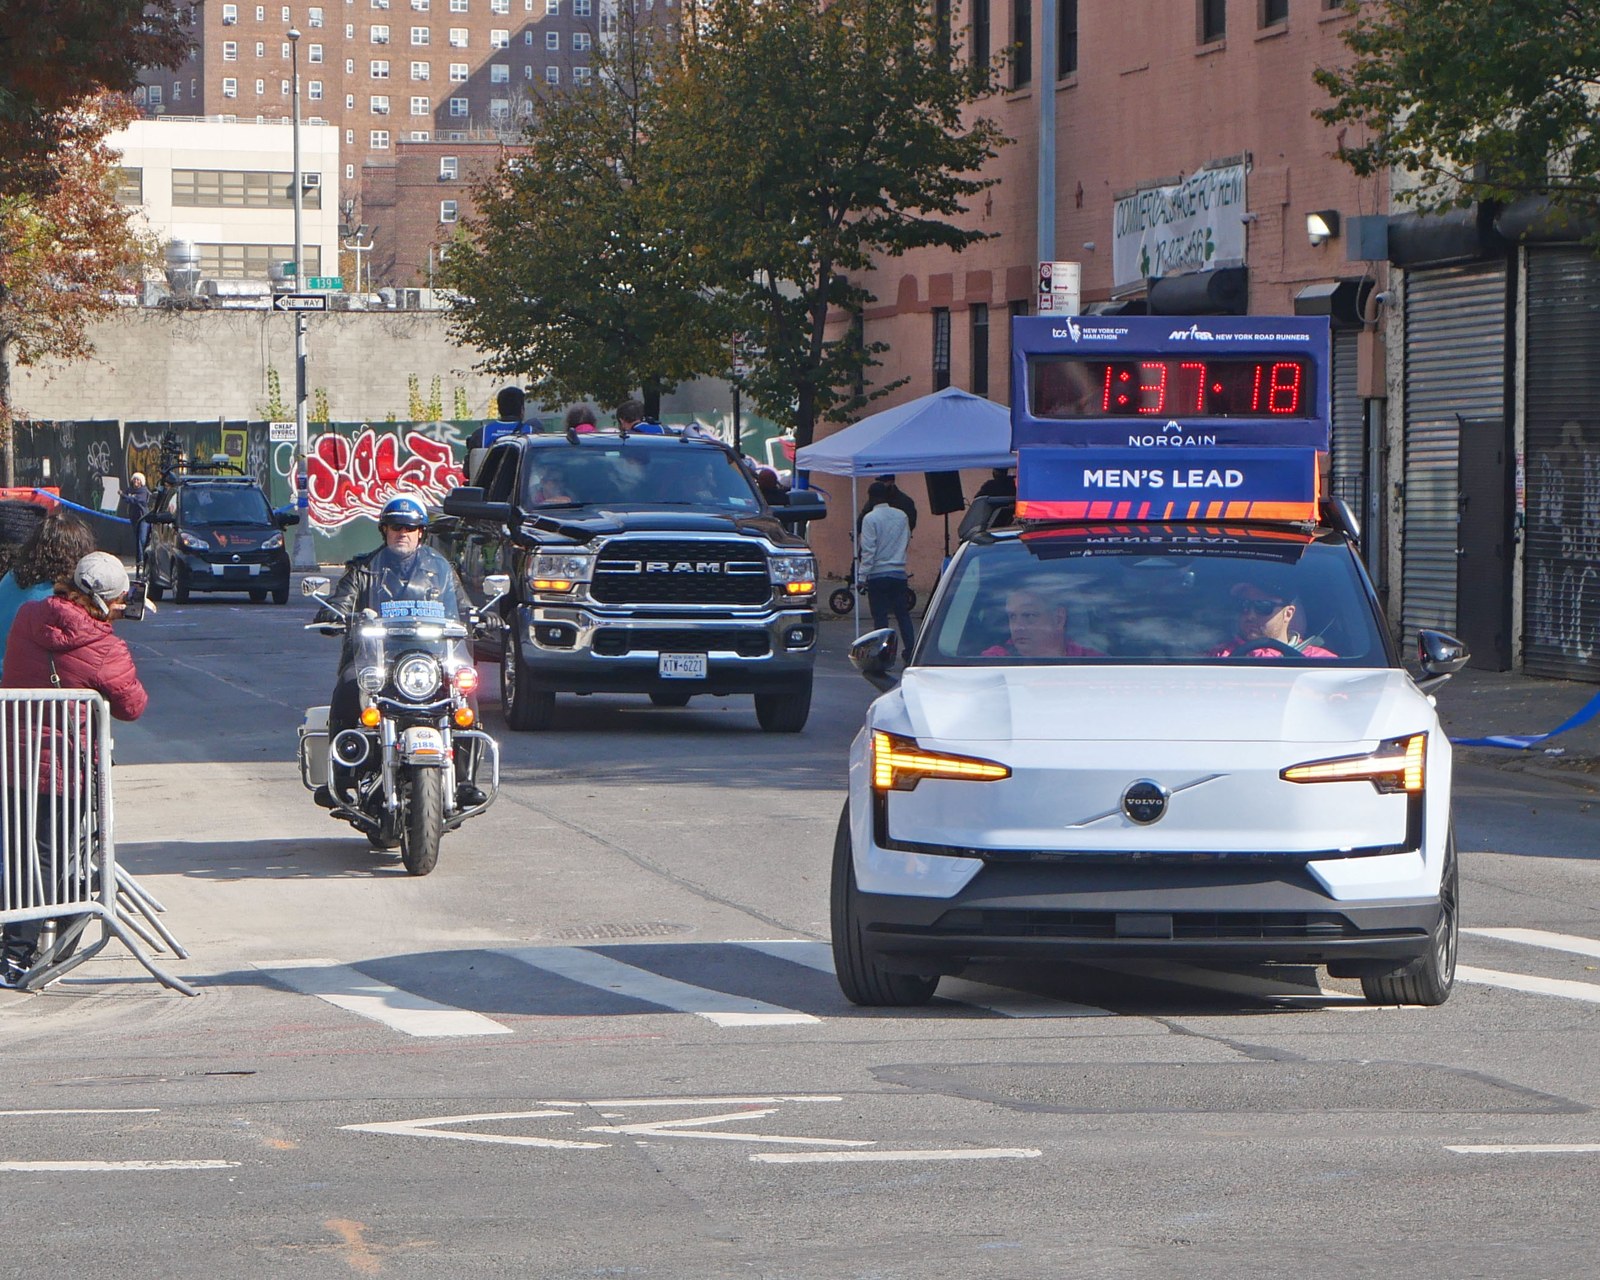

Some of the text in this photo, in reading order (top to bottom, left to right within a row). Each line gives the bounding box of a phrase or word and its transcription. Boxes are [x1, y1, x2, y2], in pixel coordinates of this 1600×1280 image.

[307, 278, 312, 288] E
[316, 278, 332, 288] 139
[280, 299, 320, 307] ONE WAY
[1052, 328, 1067, 338] tcs
[1215, 333, 1310, 341] NEW YORK ROAD RUNNERS
[1128, 434, 1217, 447] NORQAIN
[1083, 469, 1244, 488] MEN'S LEAD
[645, 561, 721, 573] RAM
[411, 741, 435, 749] 2188
